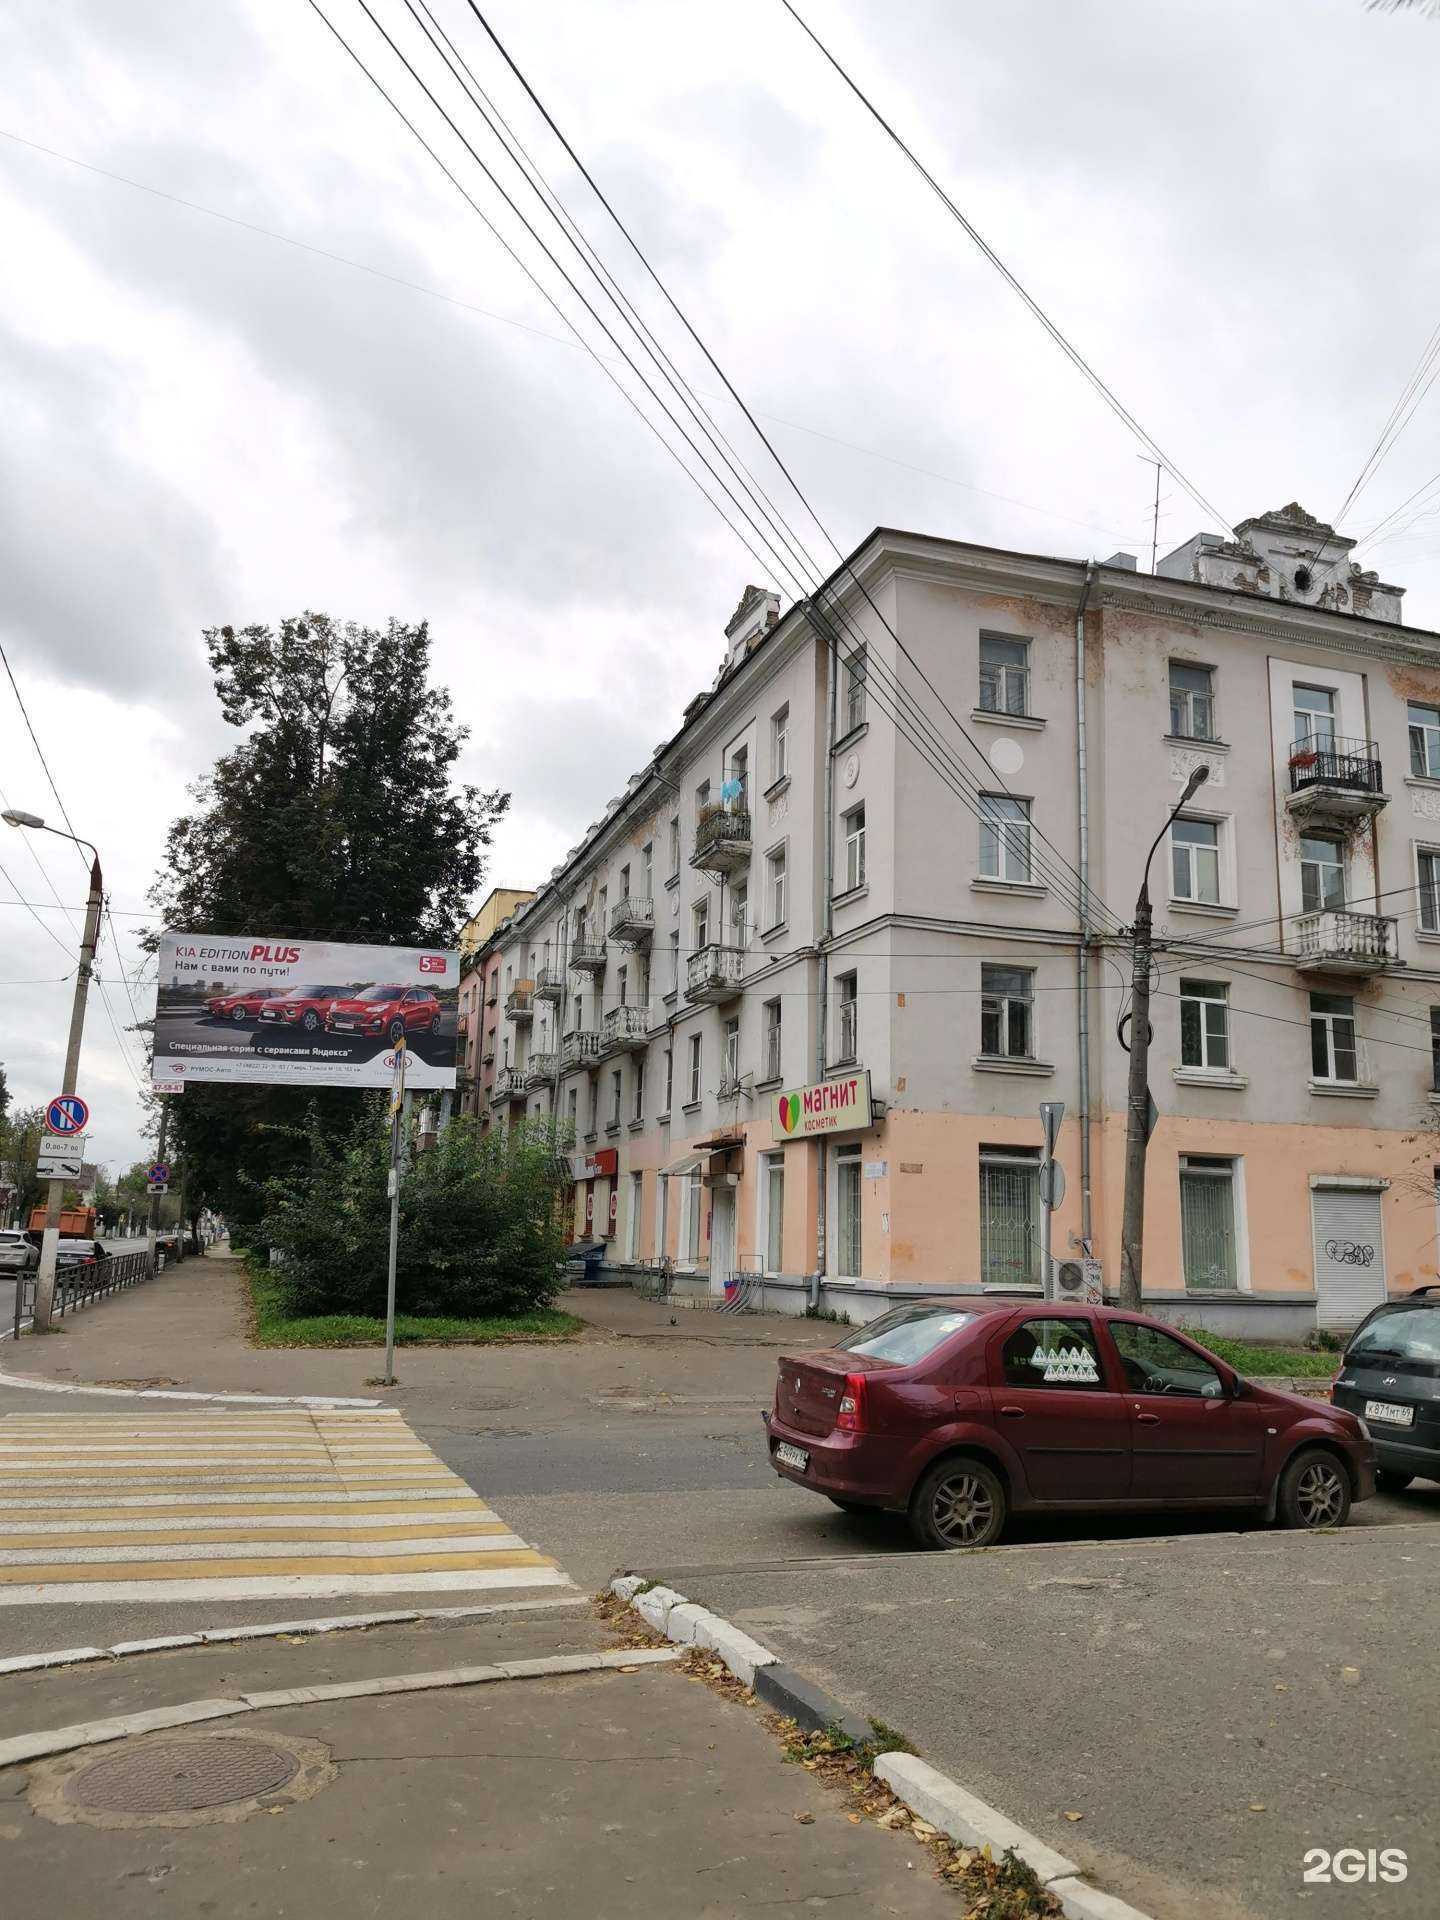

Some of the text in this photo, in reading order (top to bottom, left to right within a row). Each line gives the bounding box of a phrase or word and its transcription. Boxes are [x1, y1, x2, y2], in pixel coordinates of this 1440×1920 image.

[176, 945, 300, 963] KIA EDITION PLUS
[175, 961, 290, 978] Нам с вами по пути!
[421, 957, 431, 971] 5
[169, 1041, 228, 1052] Специальная
[264, 1047, 310, 1055] сервисами
[804, 1116, 837, 1132] косметик
